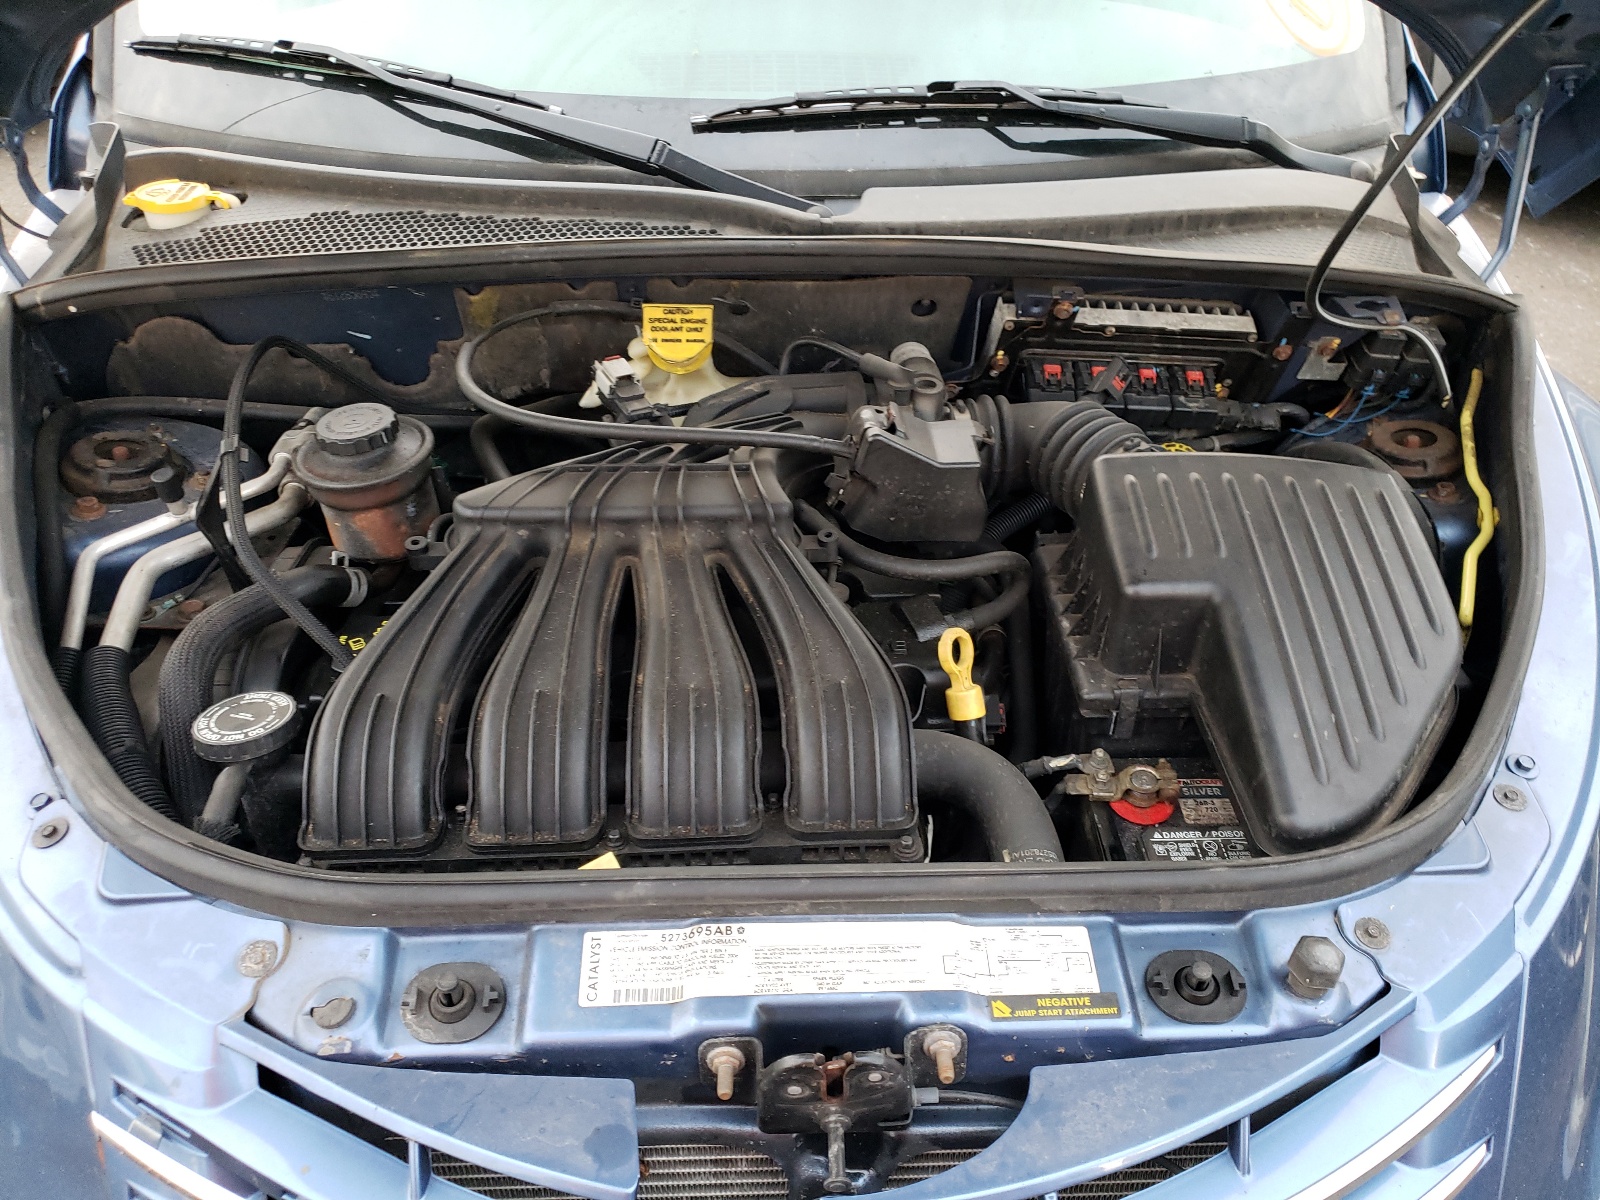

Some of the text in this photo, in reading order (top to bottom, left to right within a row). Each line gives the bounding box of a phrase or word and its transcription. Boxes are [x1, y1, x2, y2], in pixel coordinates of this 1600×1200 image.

[1182, 787, 1222, 796] SILVER
[1162, 831, 1203, 839] DANGER
[661, 926, 733, 943] 5273695AB
[586, 936, 602, 1002] CATALYST
[1036, 997, 1092, 1007] NEGATIVE
[1014, 1007, 1118, 1017] JUMP START ATTACHMENT
